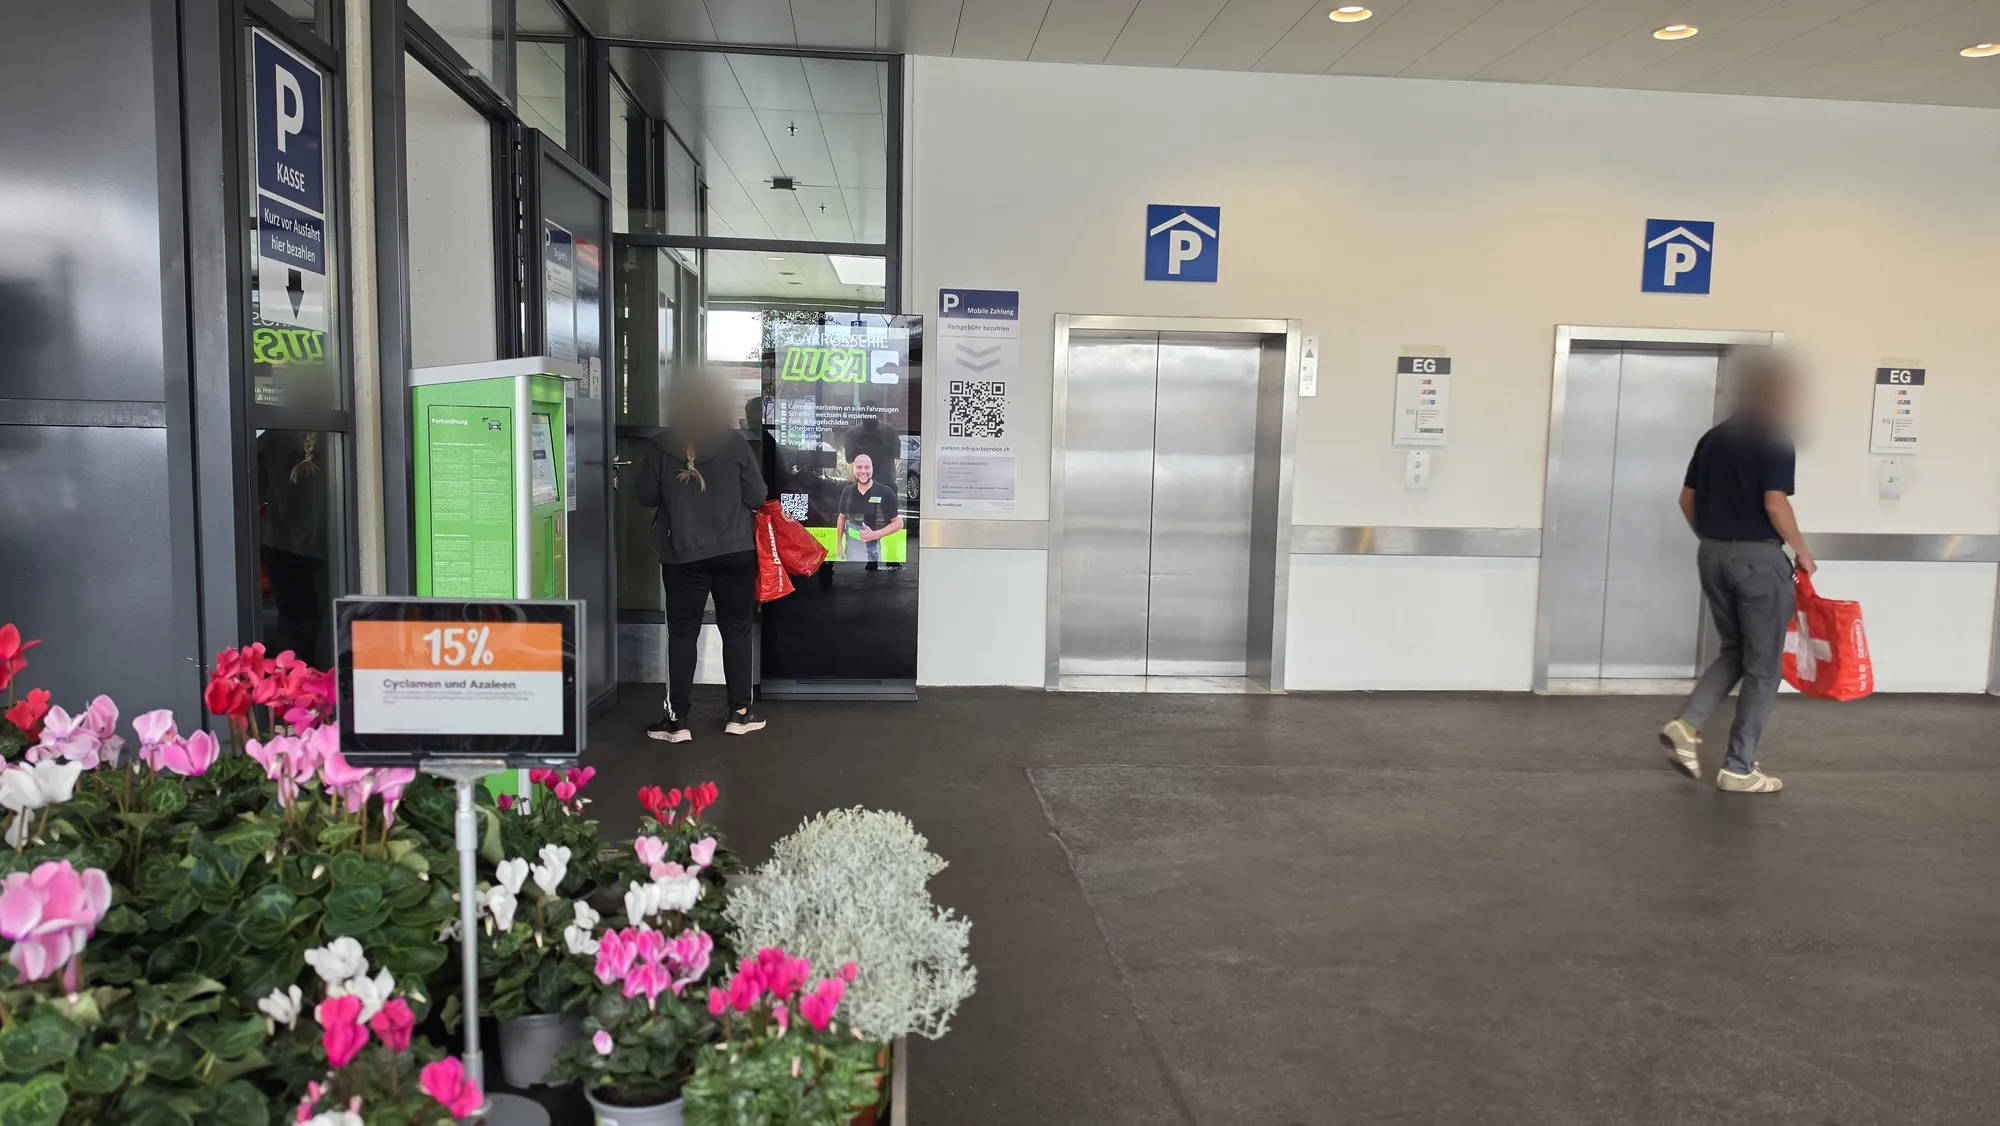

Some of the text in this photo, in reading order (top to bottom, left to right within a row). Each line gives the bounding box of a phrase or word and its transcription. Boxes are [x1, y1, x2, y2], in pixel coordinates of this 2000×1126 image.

[275, 63, 305, 153] P
[277, 161, 305, 192] KASSE
[264, 207, 321, 242] Kurz vor Ausfahrt
[271, 234, 316, 263] hier bezahlen
[1168, 229, 1202, 275] P
[1664, 243, 1697, 286] P
[943, 293, 1015, 317] P Mobile Zahlung
[947, 323, 1010, 332] Parkgebühr bezahlen
[790, 332, 889, 349] CARROSSERIE
[781, 347, 867, 384] LUSA
[1412, 358, 1436, 373] EG
[1889, 370, 1911, 384] EG
[815, 411, 842, 419] wechseln
[848, 412, 877, 420] reparieren
[866, 405, 899, 414] Fahrzeugen
[431, 418, 469, 426] Parkordnung
[423, 626, 494, 667] 15%
[382, 678, 516, 691] Cyclamen und Azaleen
